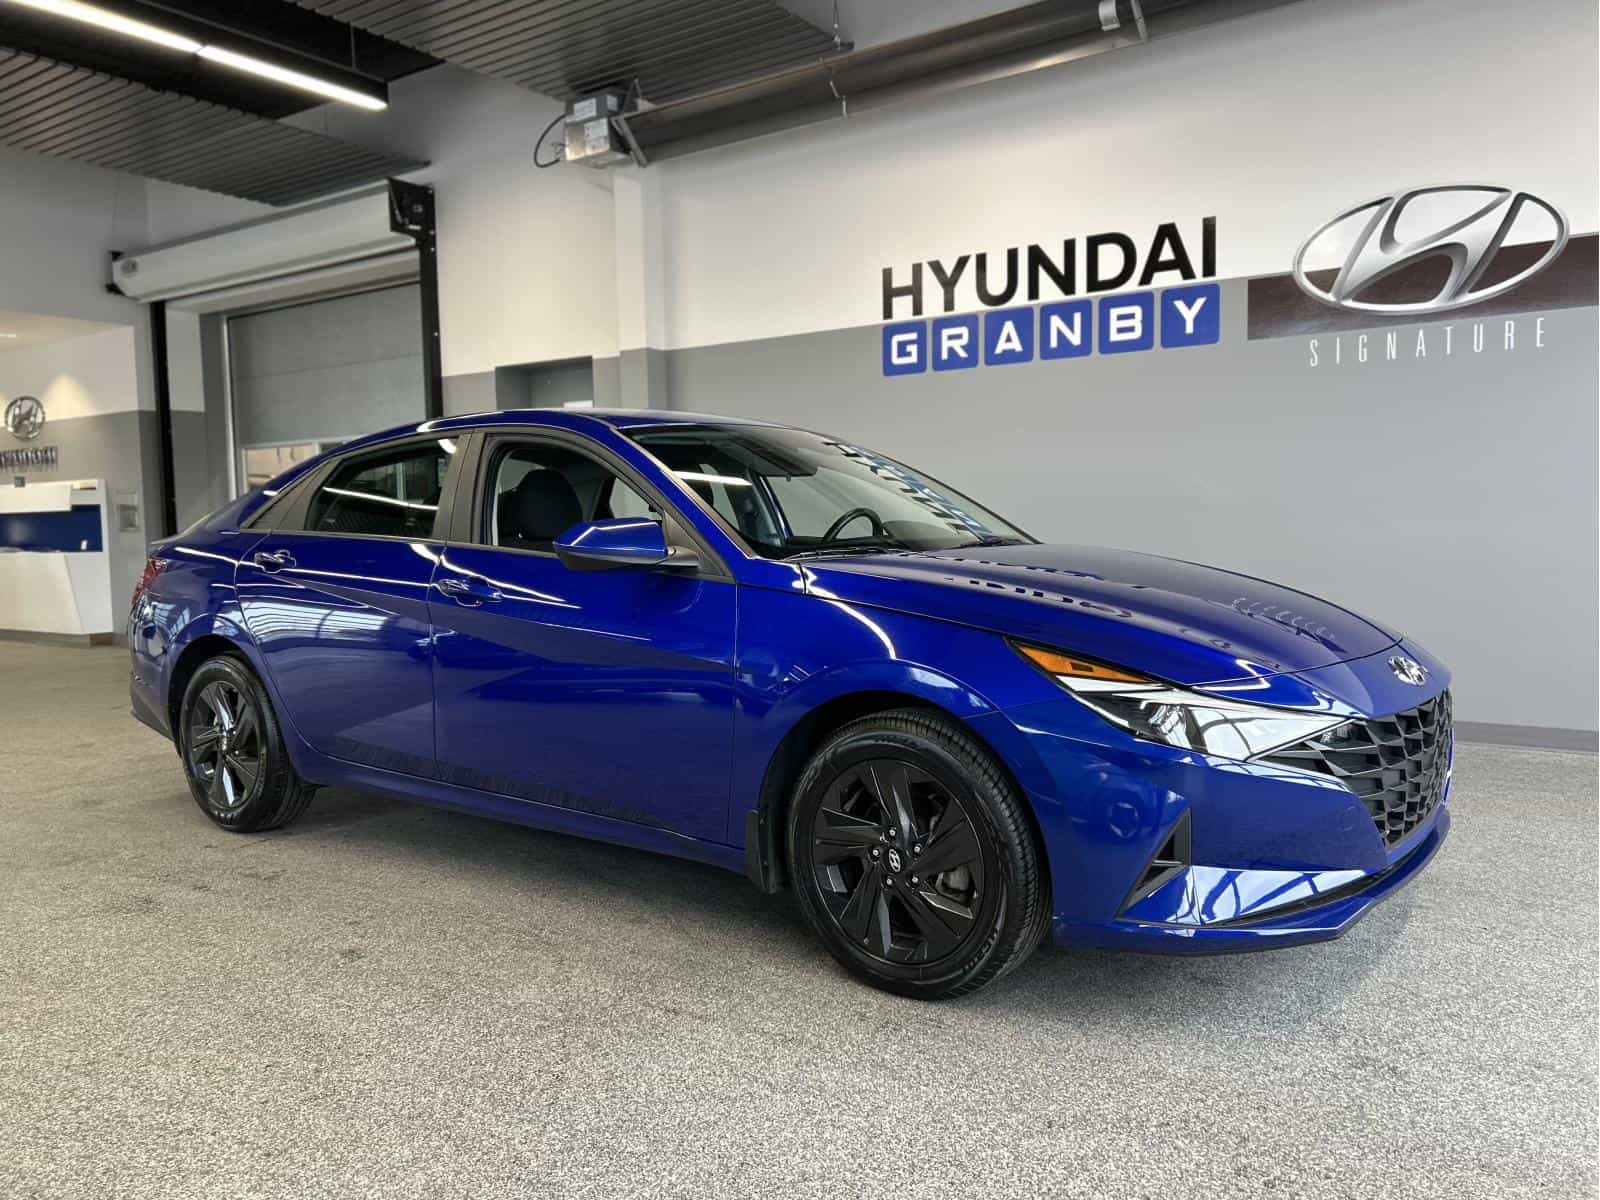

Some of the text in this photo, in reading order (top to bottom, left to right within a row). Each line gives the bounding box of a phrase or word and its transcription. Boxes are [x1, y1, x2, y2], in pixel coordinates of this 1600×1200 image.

[882, 216, 1216, 320] HYUNDAI
[891, 297, 1207, 365] GRANBY
[1309, 317, 1545, 366] SIGNATURE
